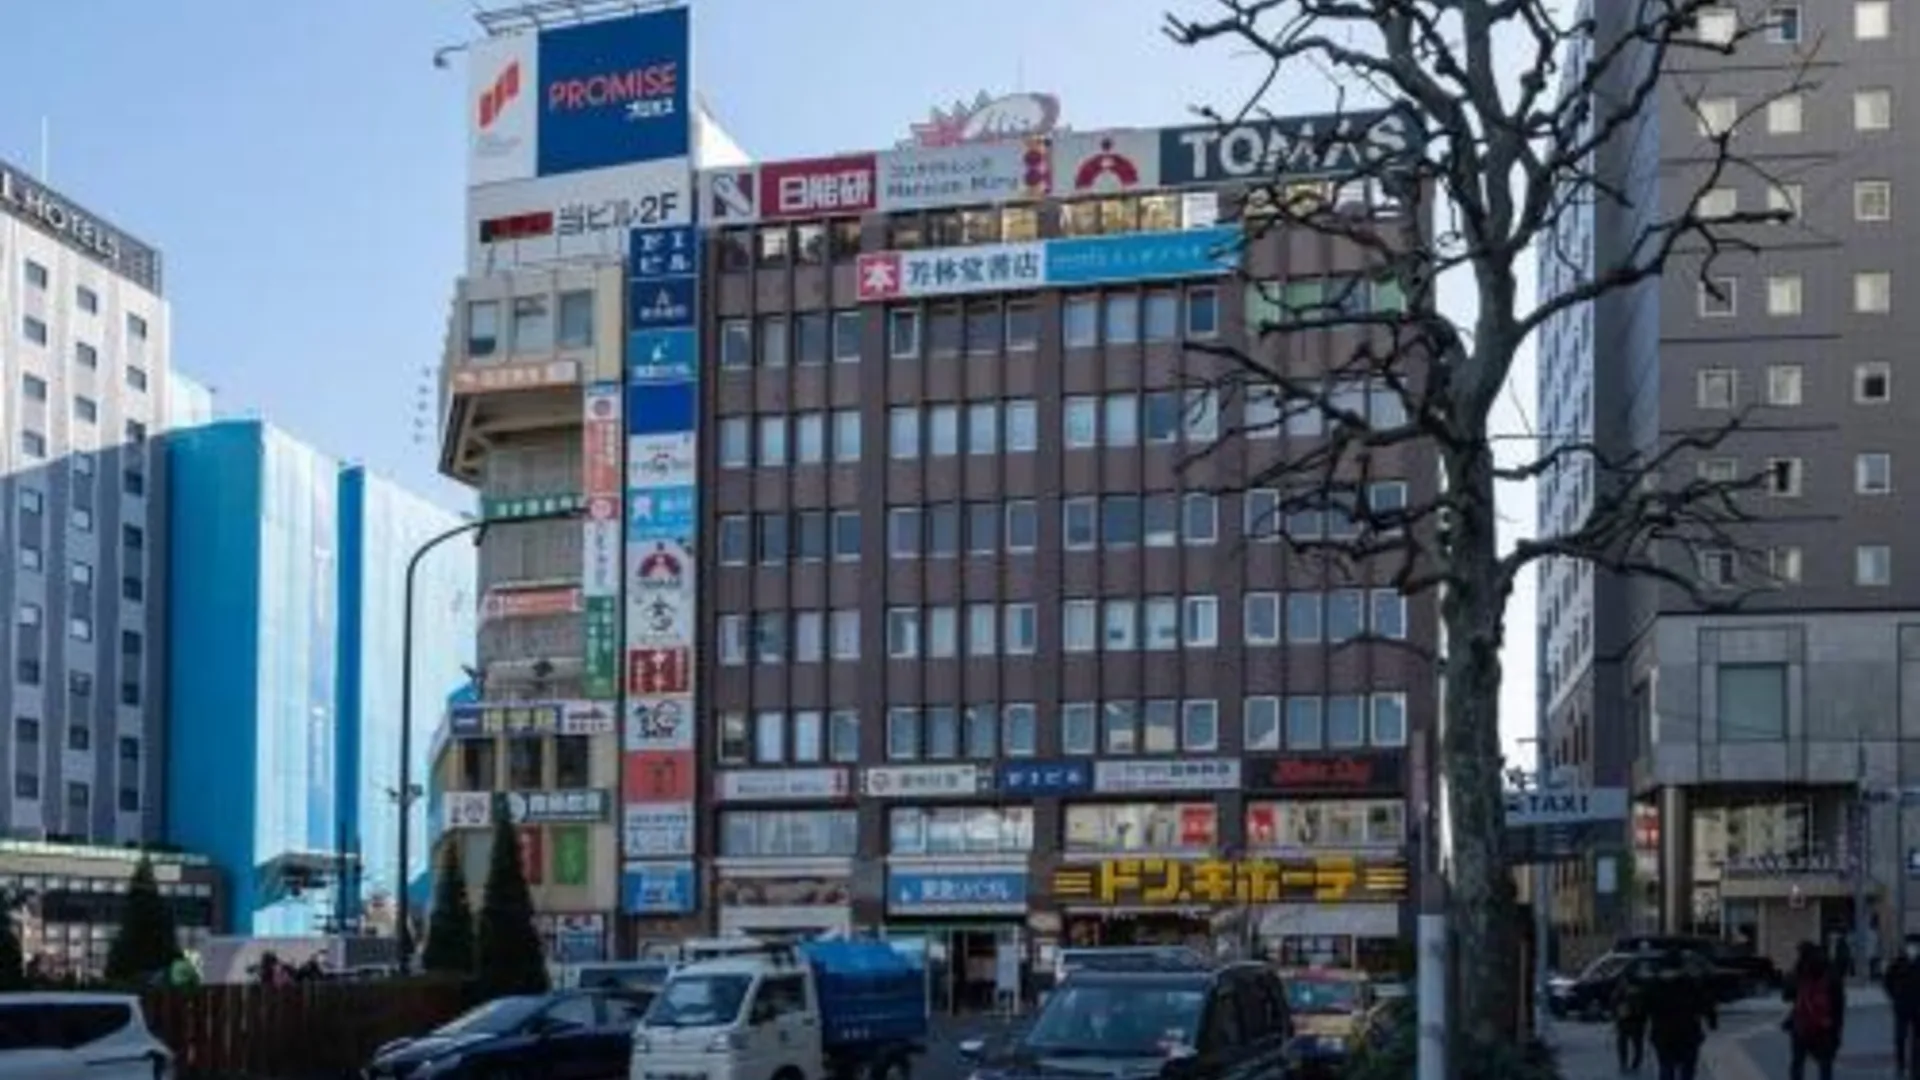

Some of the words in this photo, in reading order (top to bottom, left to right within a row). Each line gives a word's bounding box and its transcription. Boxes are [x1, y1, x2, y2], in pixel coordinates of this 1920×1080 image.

[549, 60, 677, 110] PROMISE
[1179, 113, 1407, 180] TOMAS
[908, 252, 1040, 286] 芳林堂書店
[1528, 793, 1590, 814] TAXI
